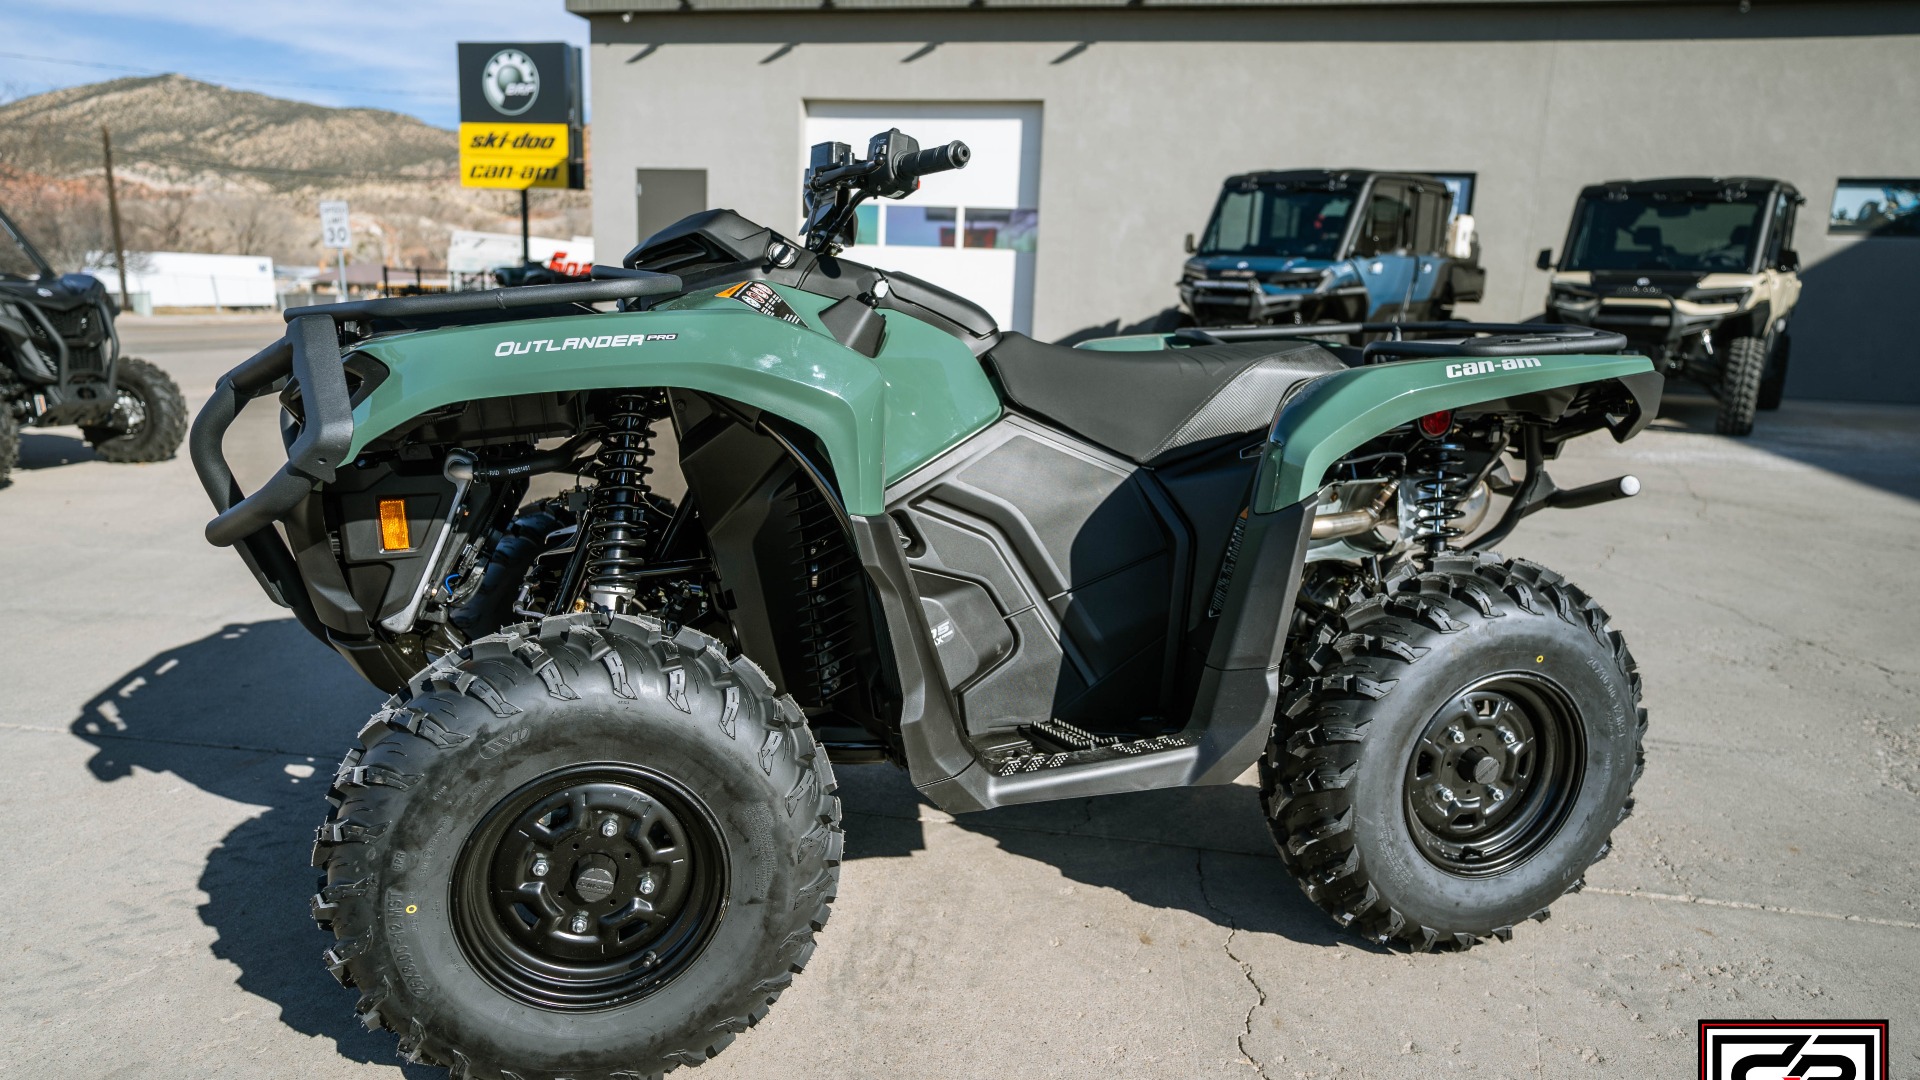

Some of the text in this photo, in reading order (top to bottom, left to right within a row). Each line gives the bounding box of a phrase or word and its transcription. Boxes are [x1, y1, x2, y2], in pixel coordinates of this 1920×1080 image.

[470, 131, 556, 149] ski-doo
[470, 165, 559, 180] can-am
[326, 226, 347, 242] 30
[1446, 358, 1541, 378] can-am
